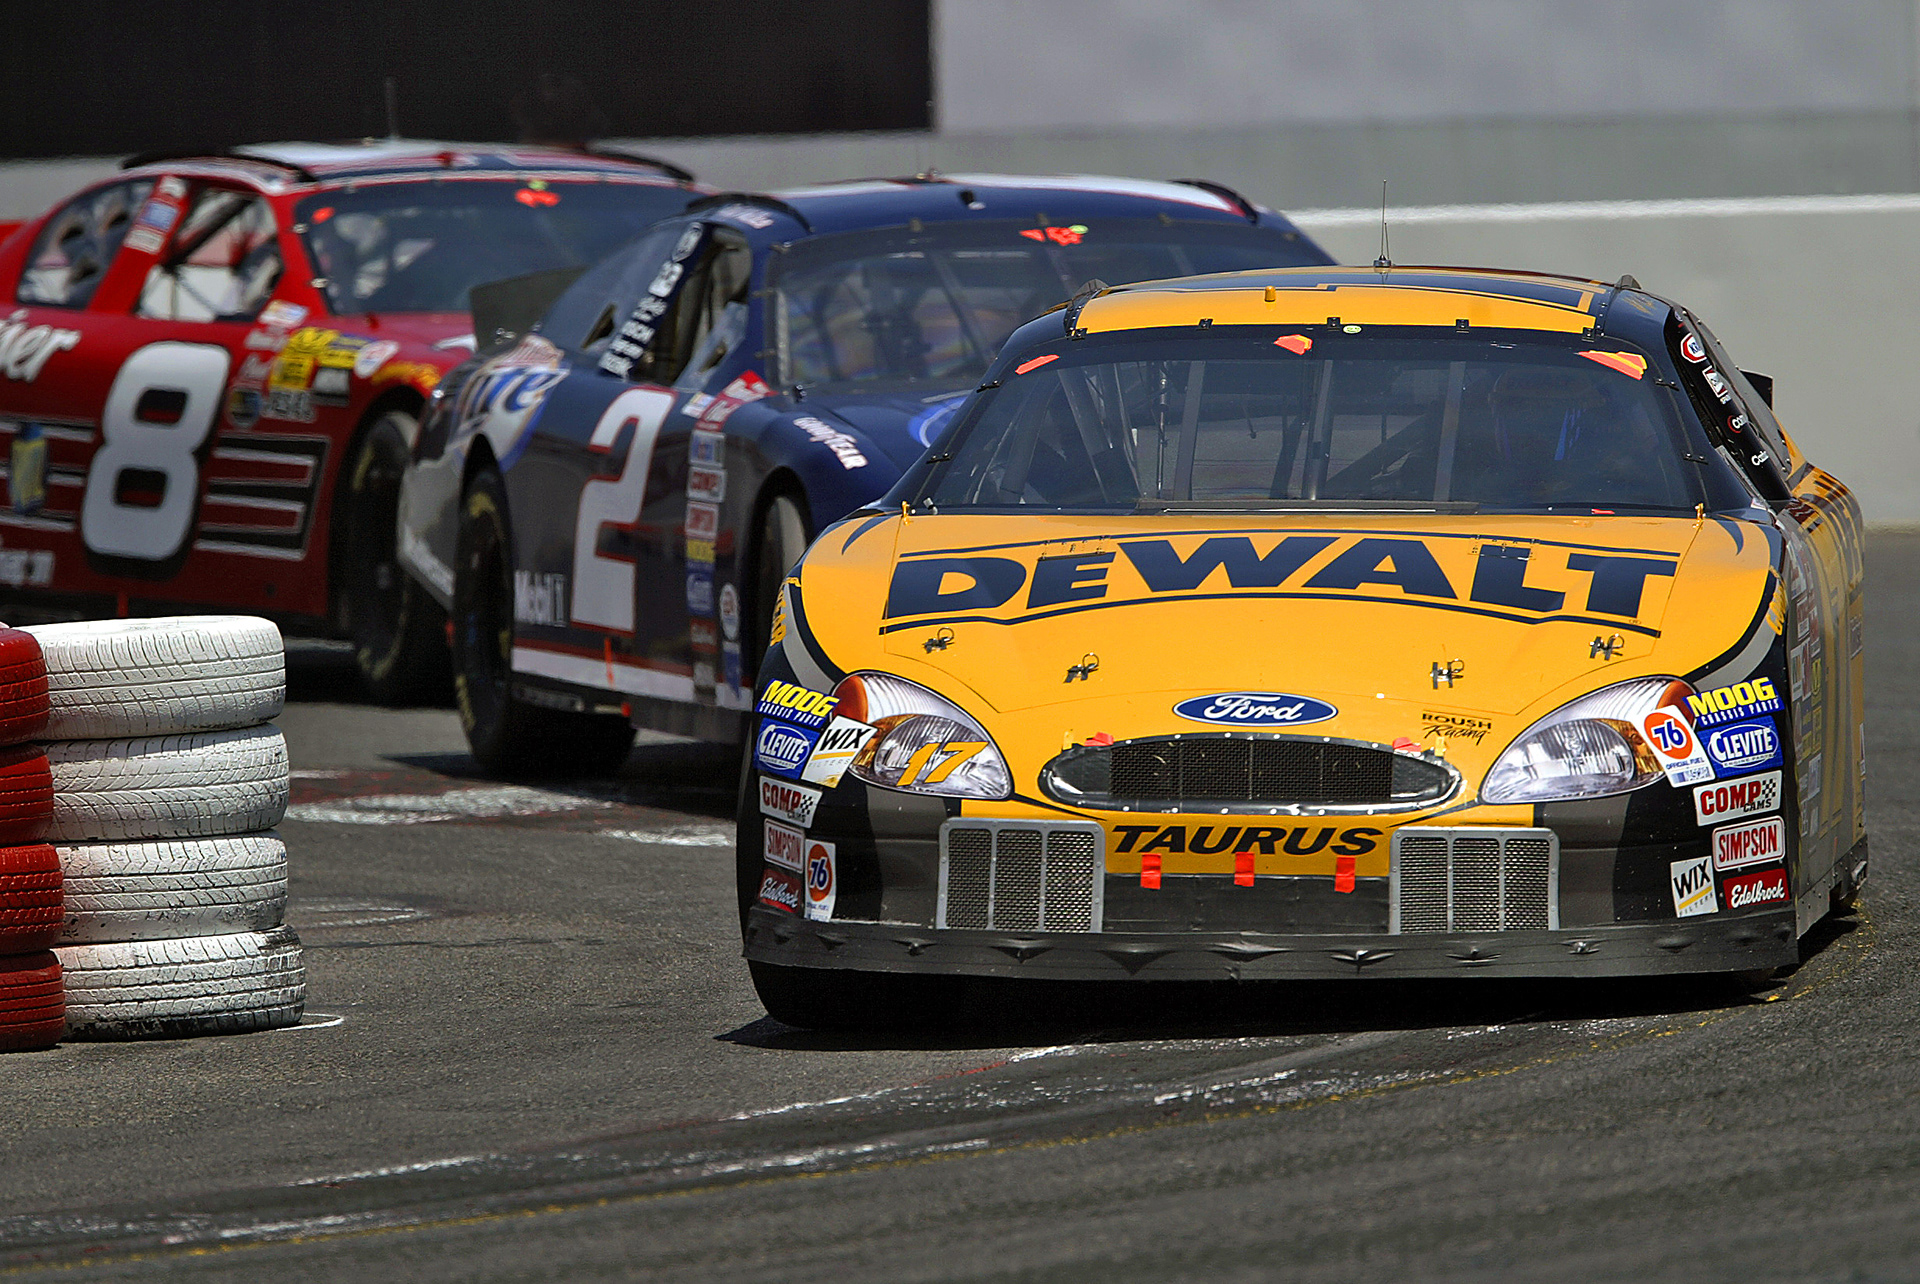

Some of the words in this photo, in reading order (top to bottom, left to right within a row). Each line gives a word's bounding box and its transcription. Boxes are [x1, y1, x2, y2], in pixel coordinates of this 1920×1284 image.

[82, 340, 231, 562] 8
[570, 384, 678, 637] 2
[882, 536, 1678, 619] DEWALT
[761, 679, 840, 718] MOOG
[1203, 695, 1306, 722] Ford
[1686, 676, 1777, 718] MOOG
[1701, 706, 1745, 726] CHASSIS
[1749, 698, 1780, 715] PARTS
[759, 702, 793, 719] CHASSIS
[794, 711, 823, 727] PARTS
[1422, 713, 1492, 730] ROUSH
[760, 723, 810, 762] CLEVITE
[820, 728, 872, 752] WIX
[1422, 724, 1488, 747] Racing
[1651, 718, 1687, 752] 76
[1710, 727, 1774, 762] CLEVITE
[897, 741, 990, 787] 17
[762, 781, 802, 812] COMP
[1701, 780, 1762, 816] COMP
[1743, 798, 1772, 813] CAMS
[768, 826, 801, 864] SIMPSON
[1112, 825, 1387, 856] TAURUS
[1719, 824, 1778, 863] SIMPSON
[809, 857, 828, 890] 76
[1673, 858, 1711, 899] WIX
[1731, 878, 1785, 909] Edelbrock
